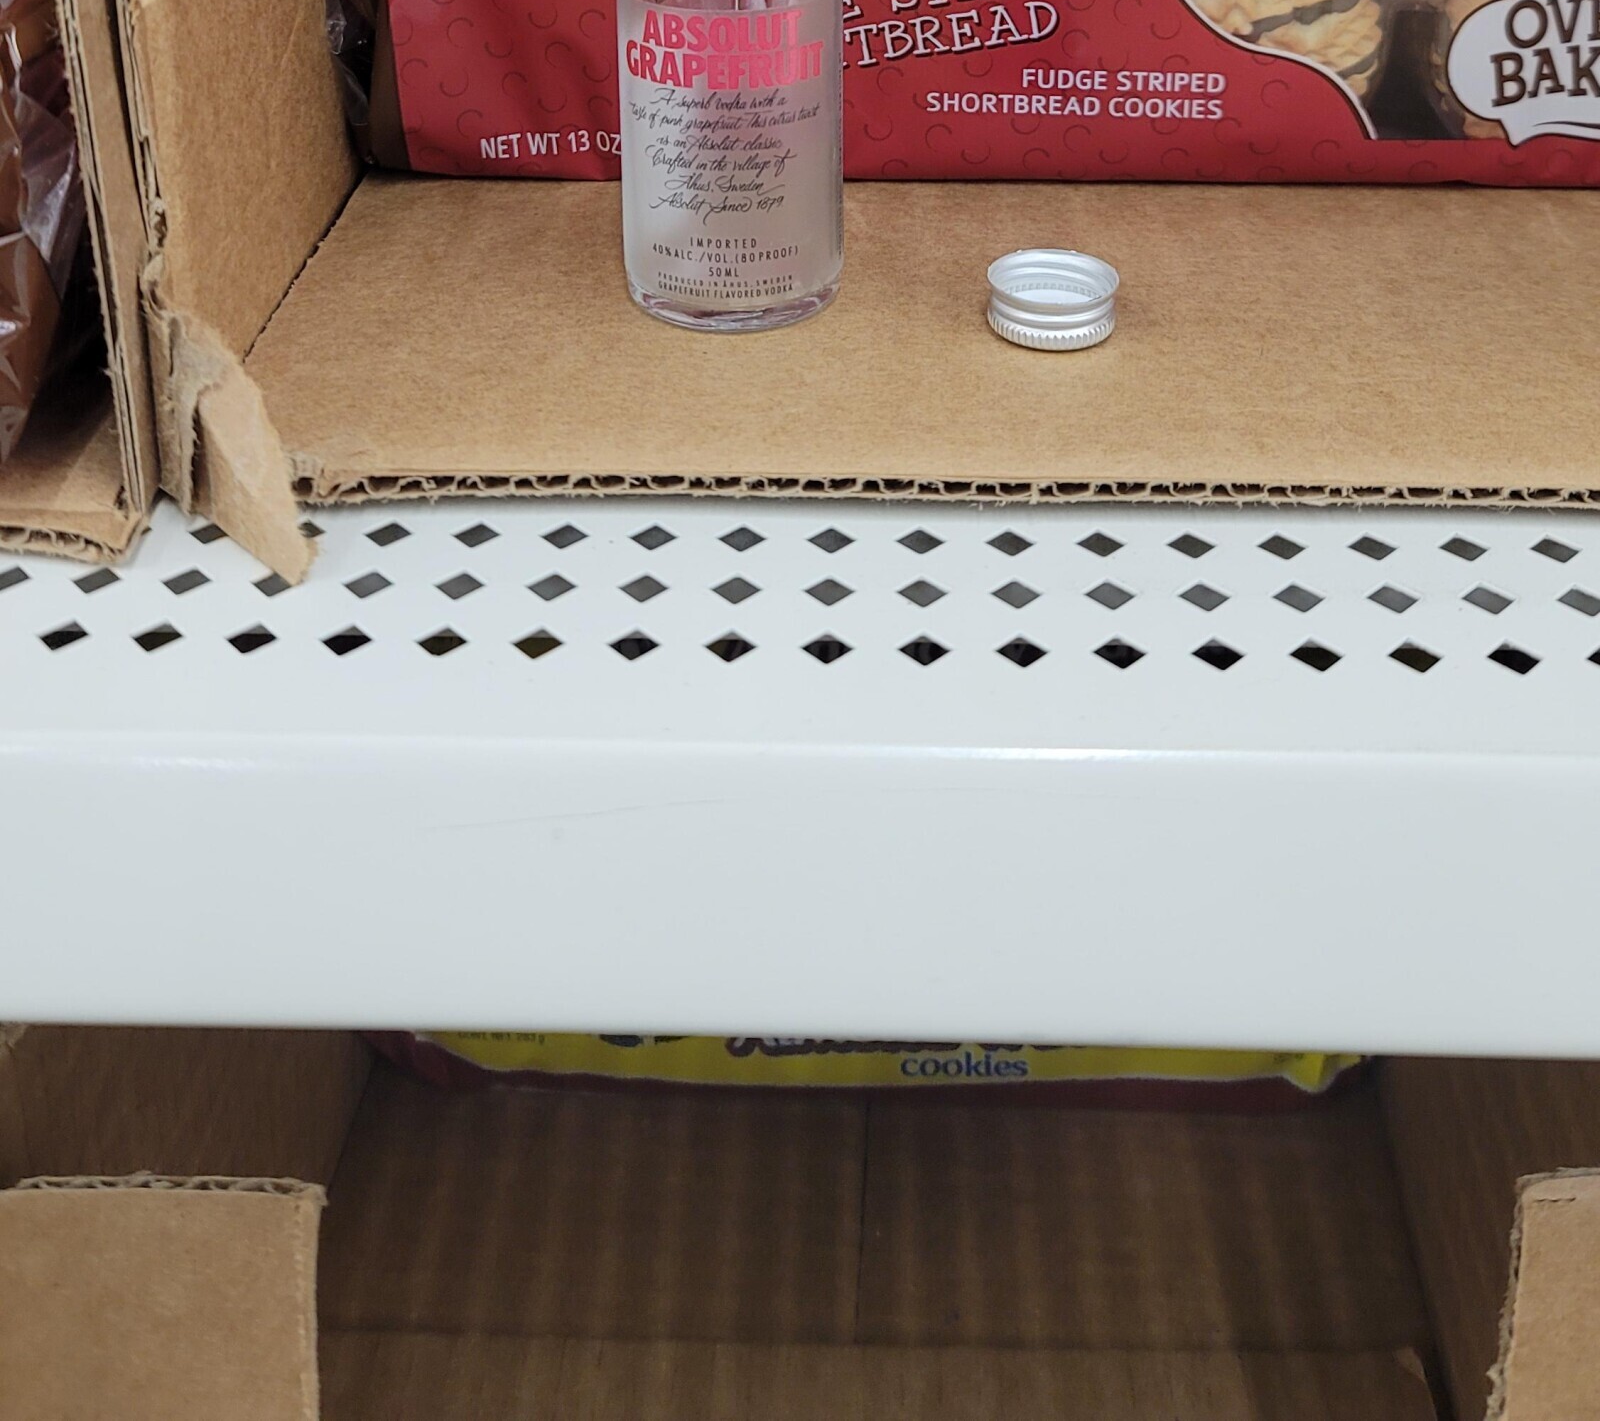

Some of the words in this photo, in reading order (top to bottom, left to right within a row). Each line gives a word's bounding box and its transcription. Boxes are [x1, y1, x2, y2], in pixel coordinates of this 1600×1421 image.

[642, 9, 803, 53] ABSOLUT
[843, 1, 1060, 67] TBREAD
[626, 40, 824, 90] GRAPEFRUIT
[1489, 45, 1600, 108] BAK
[1021, 69, 1108, 91] FUDGE
[1116, 70, 1226, 93] STRIPED
[673, 91, 714, 112] superb
[715, 92, 747, 111] vodka
[749, 88, 779, 110] with
[776, 97, 787, 106] a
[926, 92, 1100, 116] SHORTBREAD
[1108, 97, 1224, 120] COOKIES
[648, 109, 660, 129] of
[660, 114, 683, 132] pink
[744, 110, 768, 128] This
[480, 133, 521, 159] NET
[526, 132, 560, 155] WT
[567, 130, 591, 153] 13
[596, 131, 621, 156] OZ
[673, 139, 687, 148] an
[686, 134, 741, 153] Absolut
[645, 144, 698, 174] Crafted
[709, 155, 728, 171] the
[732, 153, 772, 178] village
[773, 148, 798, 178] of
[649, 192, 707, 216] Absolut
[702, 196, 752, 226] Since
[690, 237, 757, 249] IMPORTED
[659, 281, 710, 298] GRAPEFRUIT
[714, 289, 761, 299] FLAVORED
[765, 284, 793, 296] VODKA
[900, 1050, 1029, 1077] cookies
